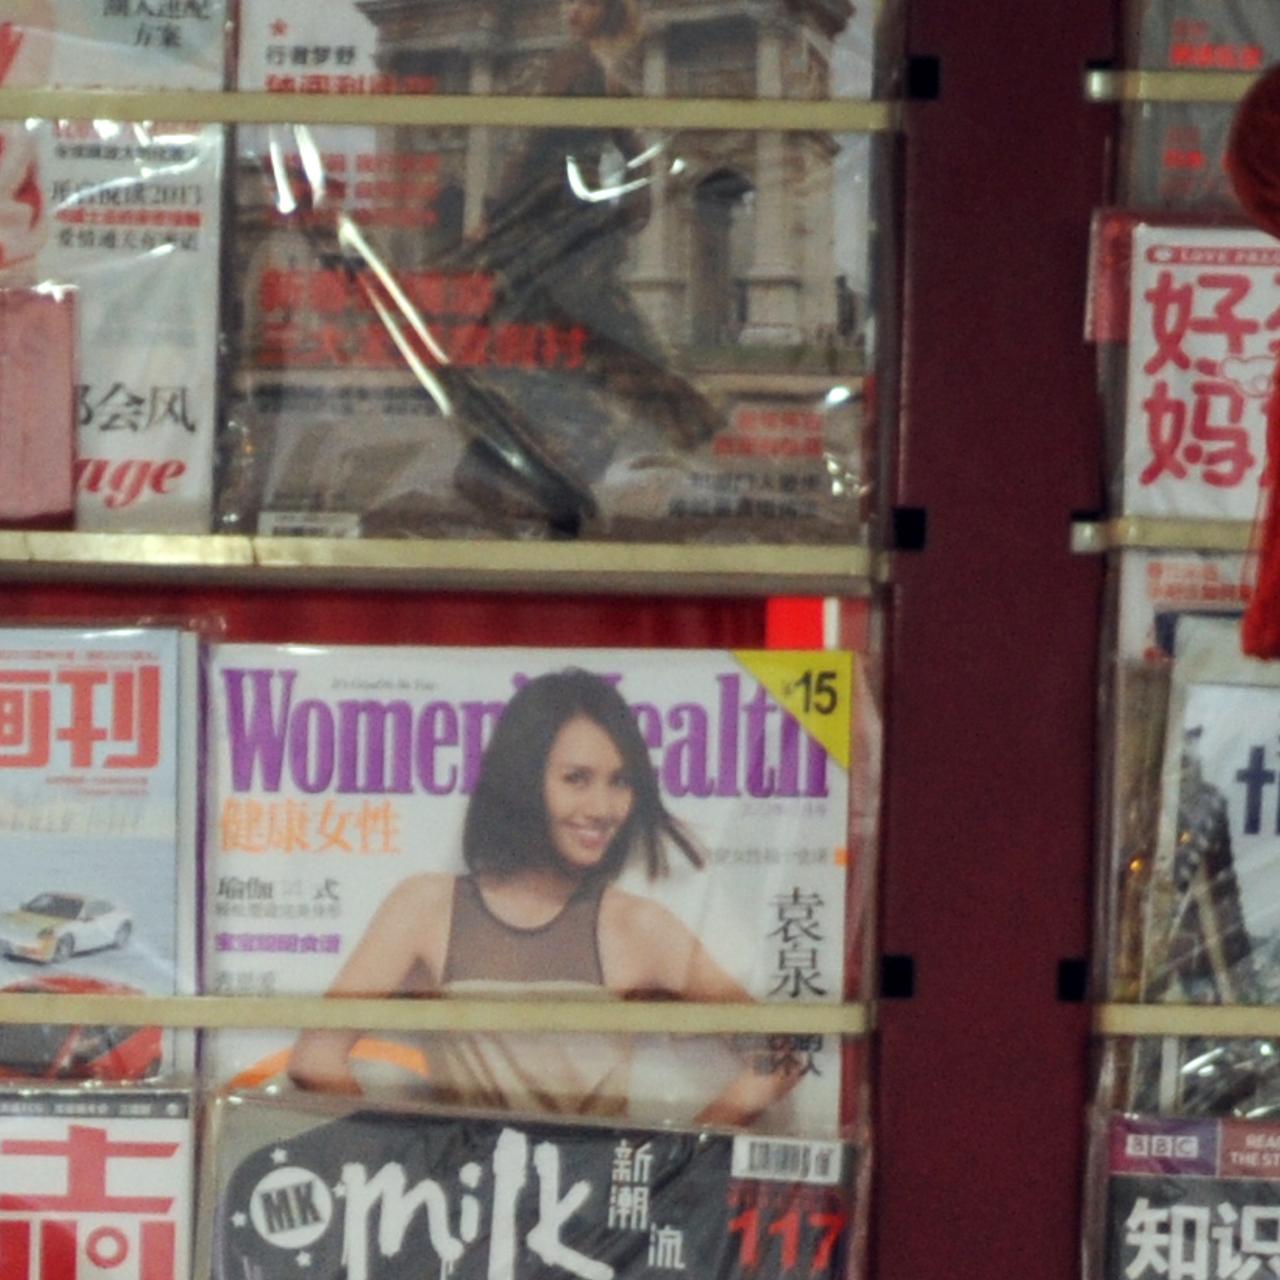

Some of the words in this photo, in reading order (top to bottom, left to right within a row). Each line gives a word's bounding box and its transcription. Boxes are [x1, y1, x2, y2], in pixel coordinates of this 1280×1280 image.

[219, 800, 402, 856] 健康女性
[766, 887, 830, 998] 袁泉
[1126, 1134, 1199, 1158] BBC
[259, 1180, 327, 1234] MK
[729, 1209, 849, 1272] 117
